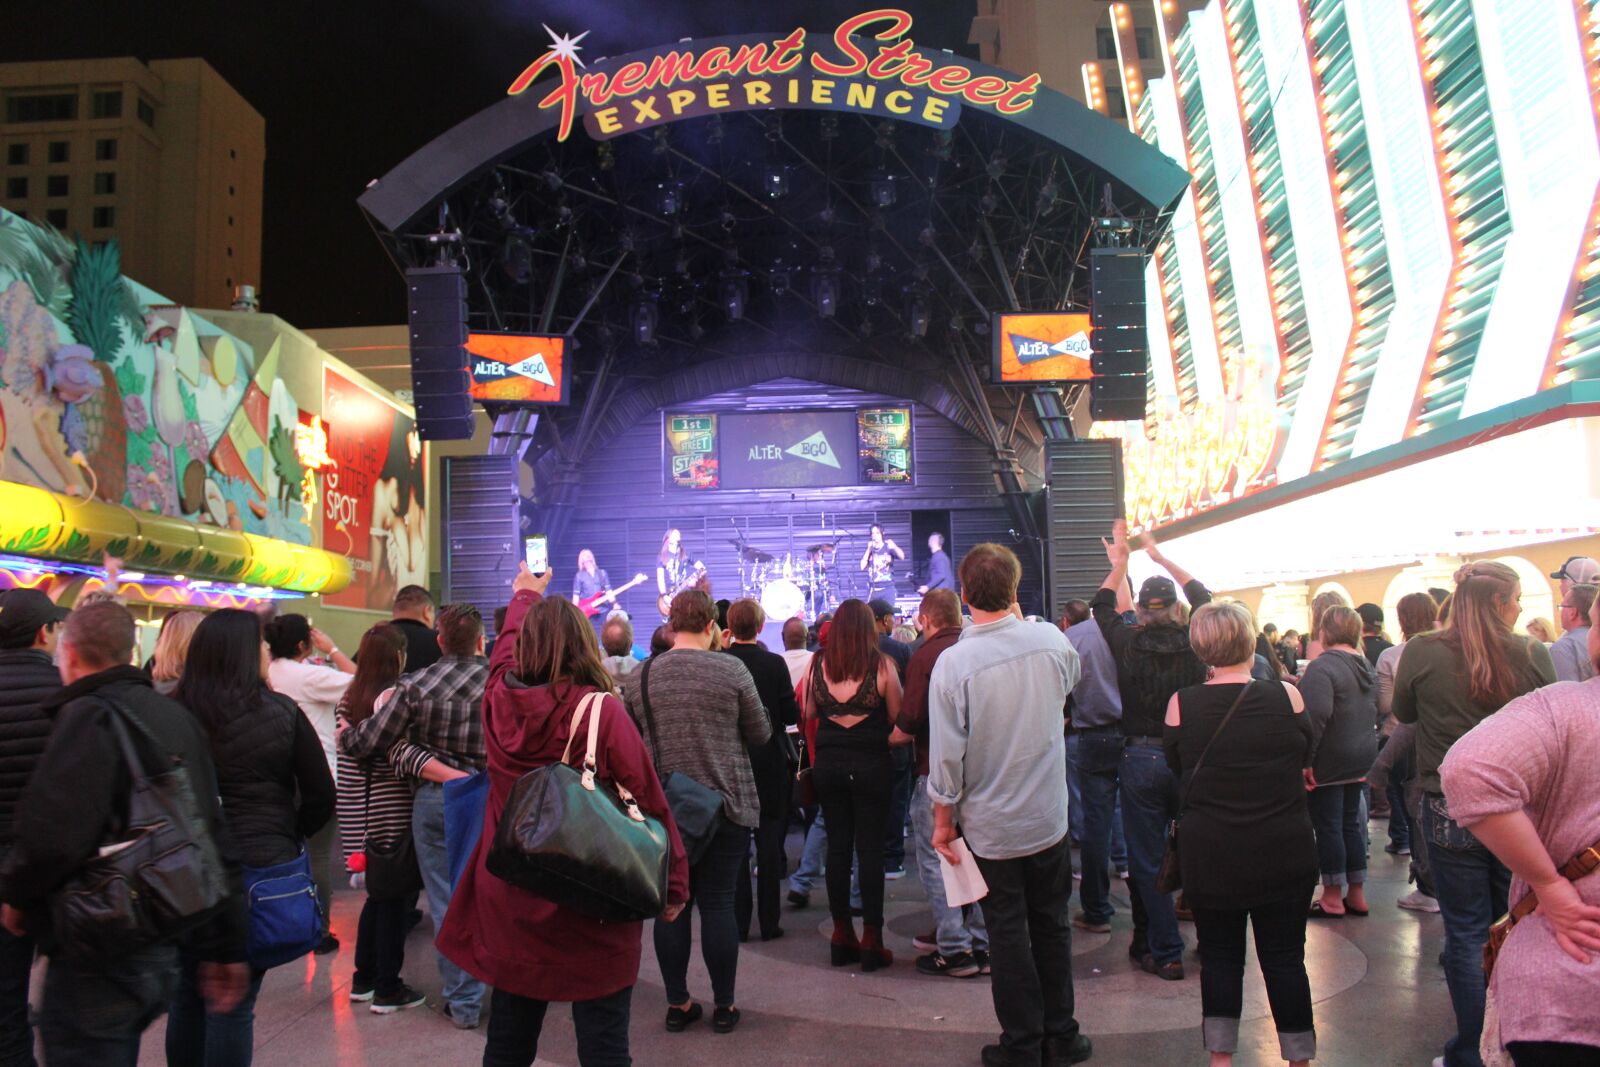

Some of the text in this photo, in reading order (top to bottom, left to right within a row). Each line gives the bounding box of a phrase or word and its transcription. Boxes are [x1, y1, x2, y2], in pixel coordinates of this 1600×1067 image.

[507, 8, 1041, 142] Fremont Street
[594, 79, 950, 135] EXPERIENCE
[1018, 339, 1088, 356] ALTER EGO
[474, 361, 545, 376] ALTER EGO
[682, 420, 701, 429] 1st
[874, 415, 893, 424] 1st
[748, 440, 828, 461] ALTER EGO
[326, 489, 360, 527] SPOT.
